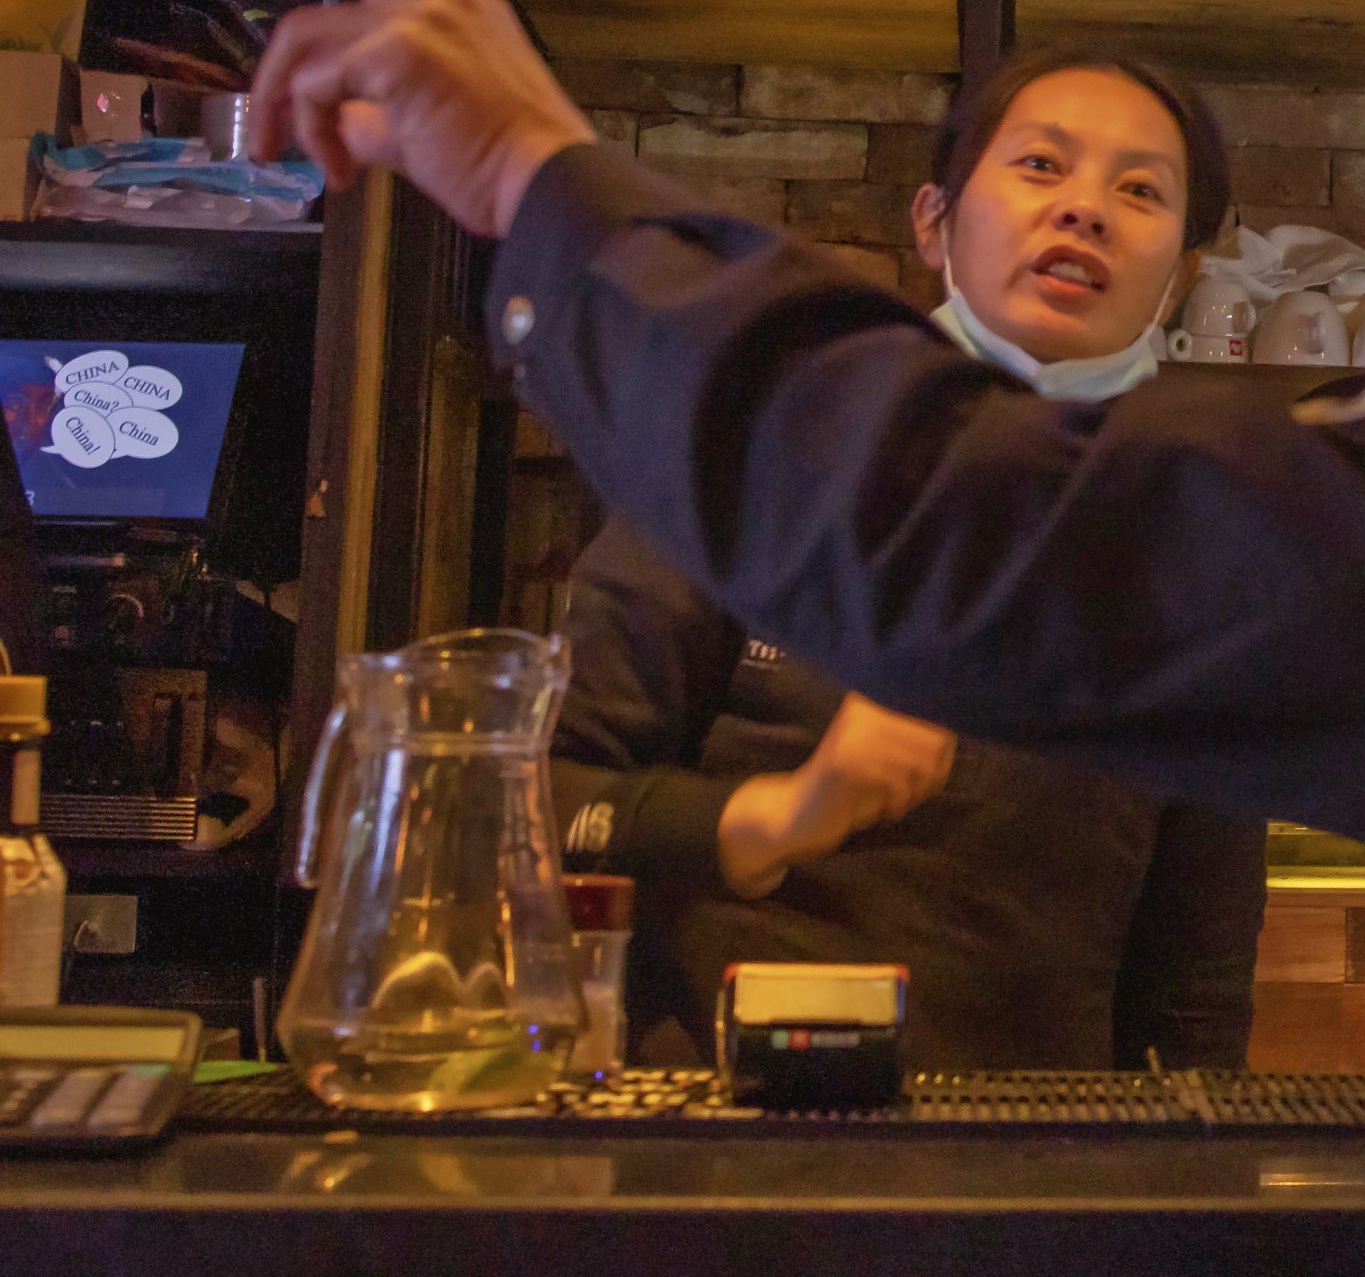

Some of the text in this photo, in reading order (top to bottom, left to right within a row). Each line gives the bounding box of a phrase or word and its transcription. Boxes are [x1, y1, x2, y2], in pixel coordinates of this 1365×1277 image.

[66, 361, 120, 385] CHINA
[74, 389, 120, 413] China?
[124, 376, 172, 401] CHINA
[65, 416, 101, 455] China!
[119, 420, 159, 446] China
